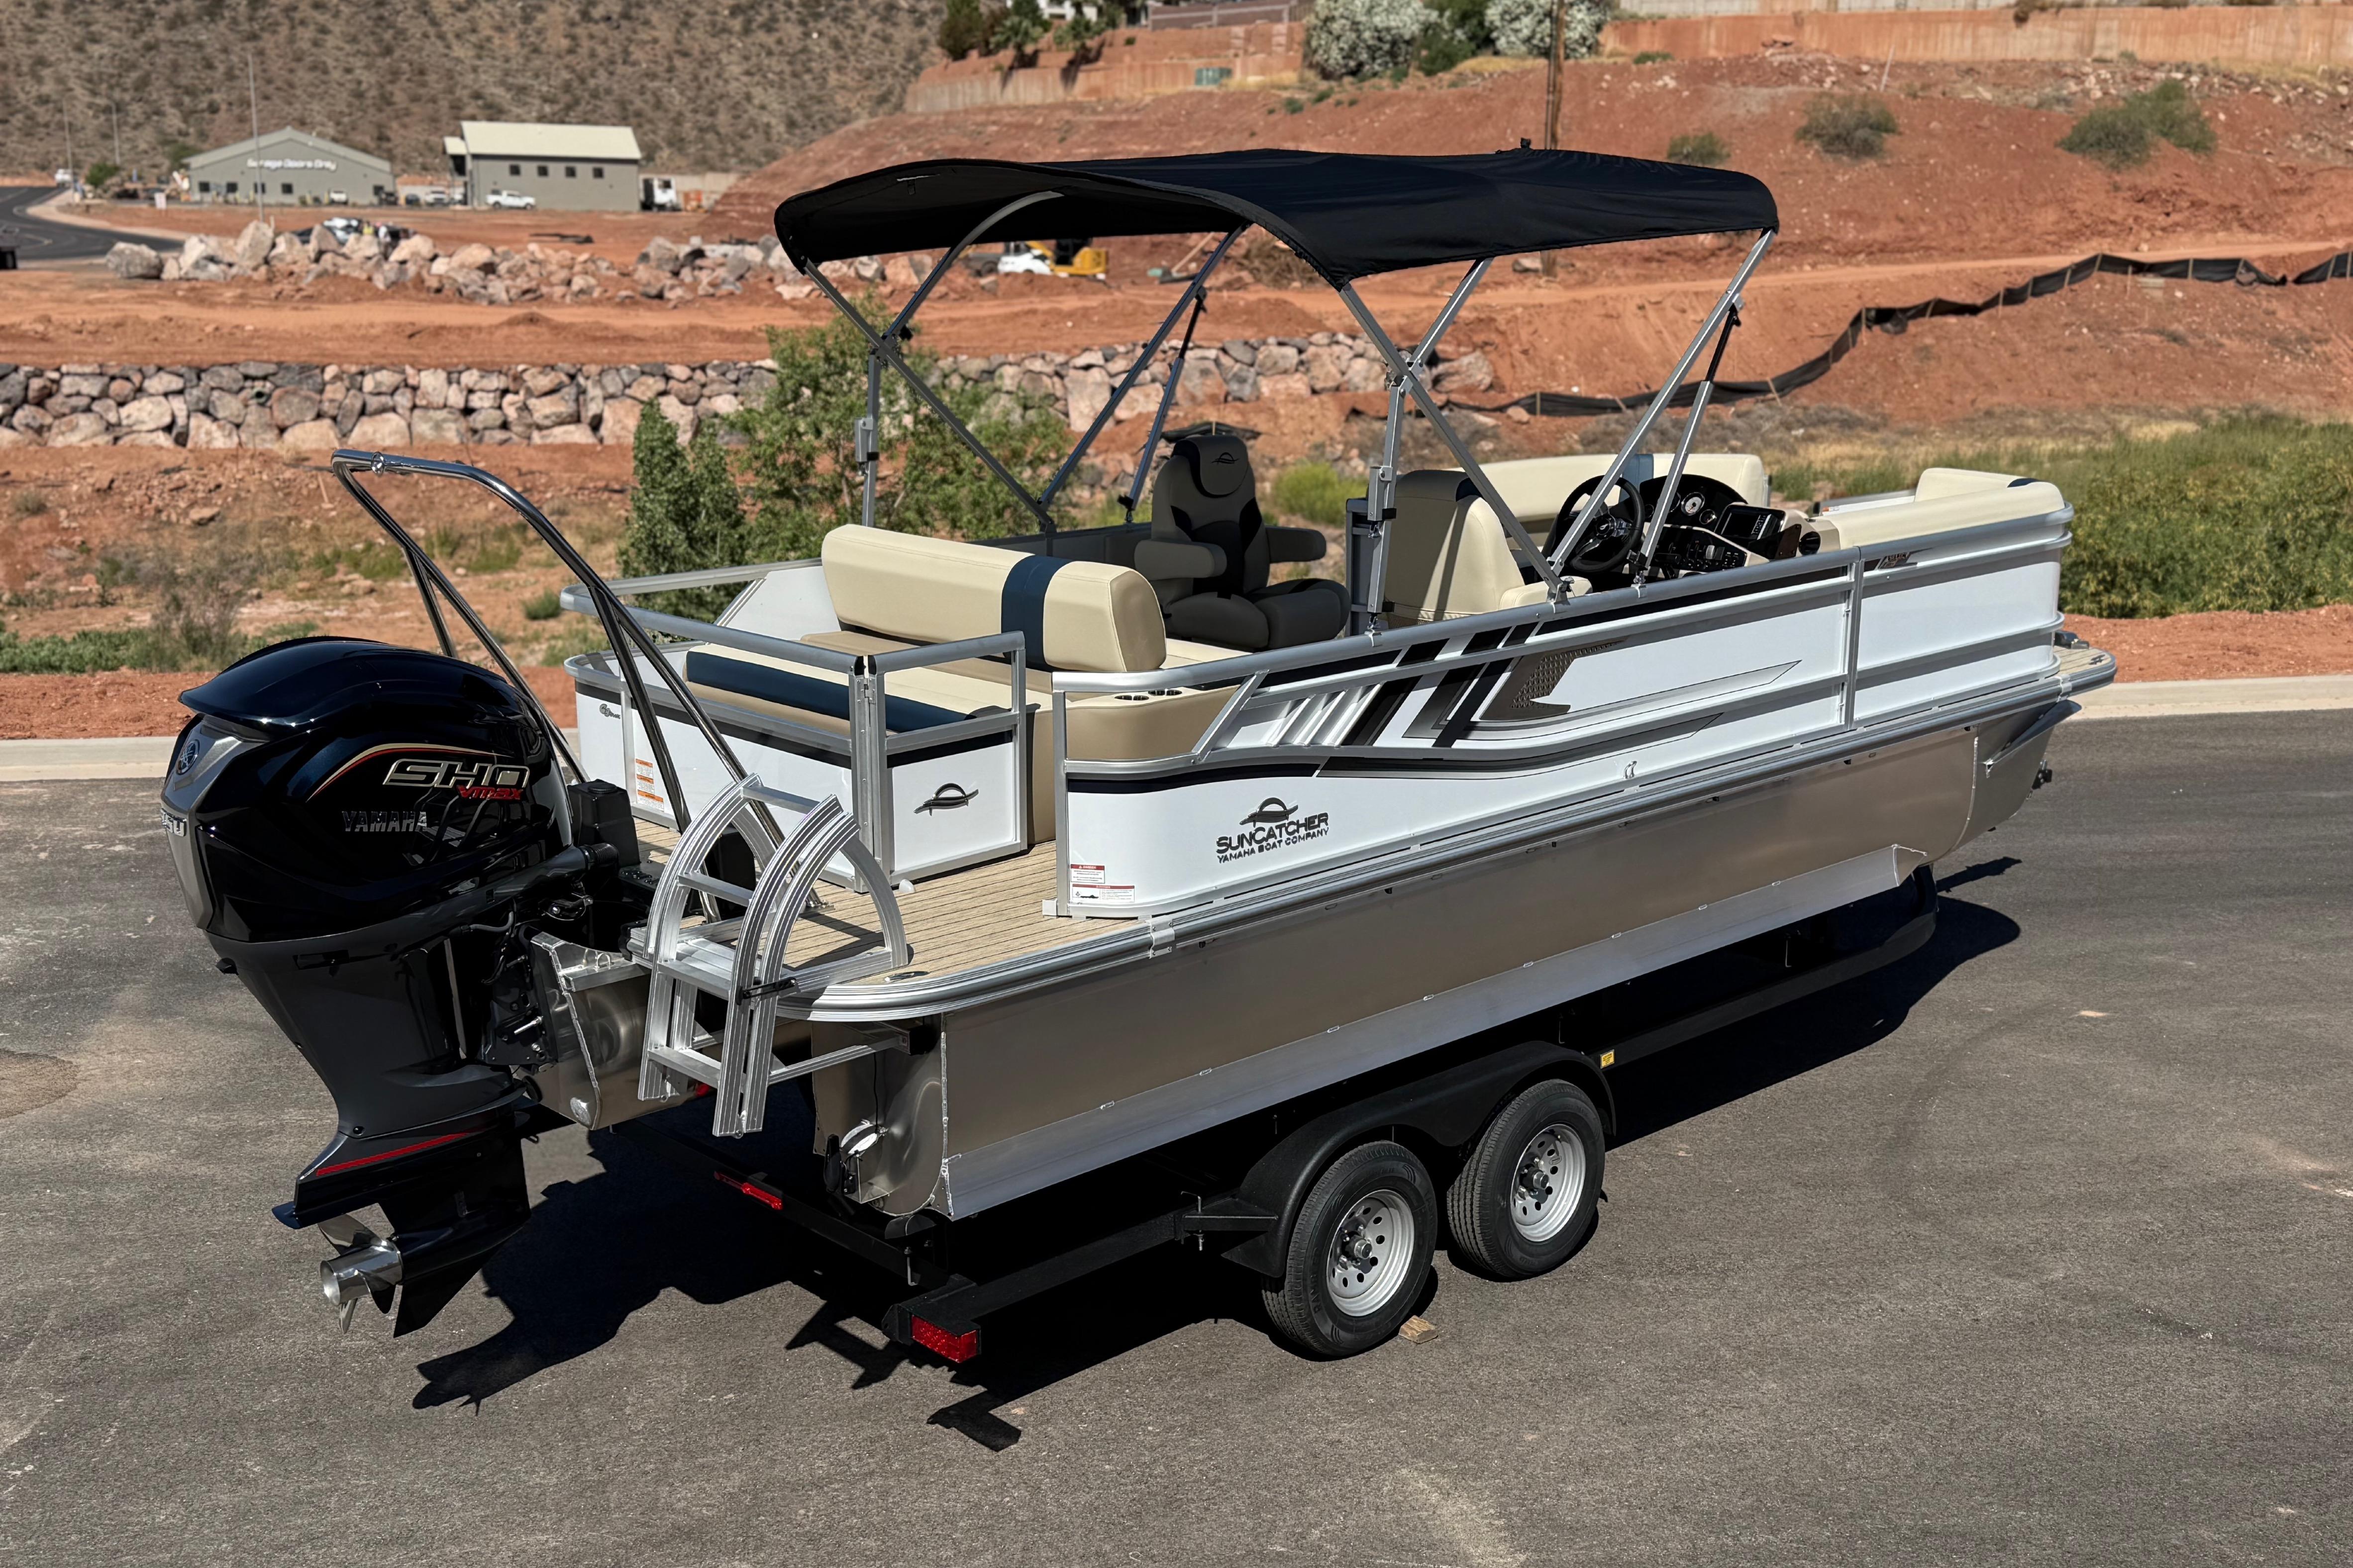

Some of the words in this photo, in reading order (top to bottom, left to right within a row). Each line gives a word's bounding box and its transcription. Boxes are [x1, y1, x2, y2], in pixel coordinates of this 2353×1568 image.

[283, 159, 313, 168] Doors
[314, 159, 336, 171] Only
[383, 759, 530, 789] SHO
[342, 811, 427, 832] YAMAHA
[1216, 812, 1329, 854] SUNCATCHER
[1217, 847, 1256, 864] YAMAHA
[1258, 839, 1283, 853] BOAT
[1285, 827, 1329, 846] COMPANY
